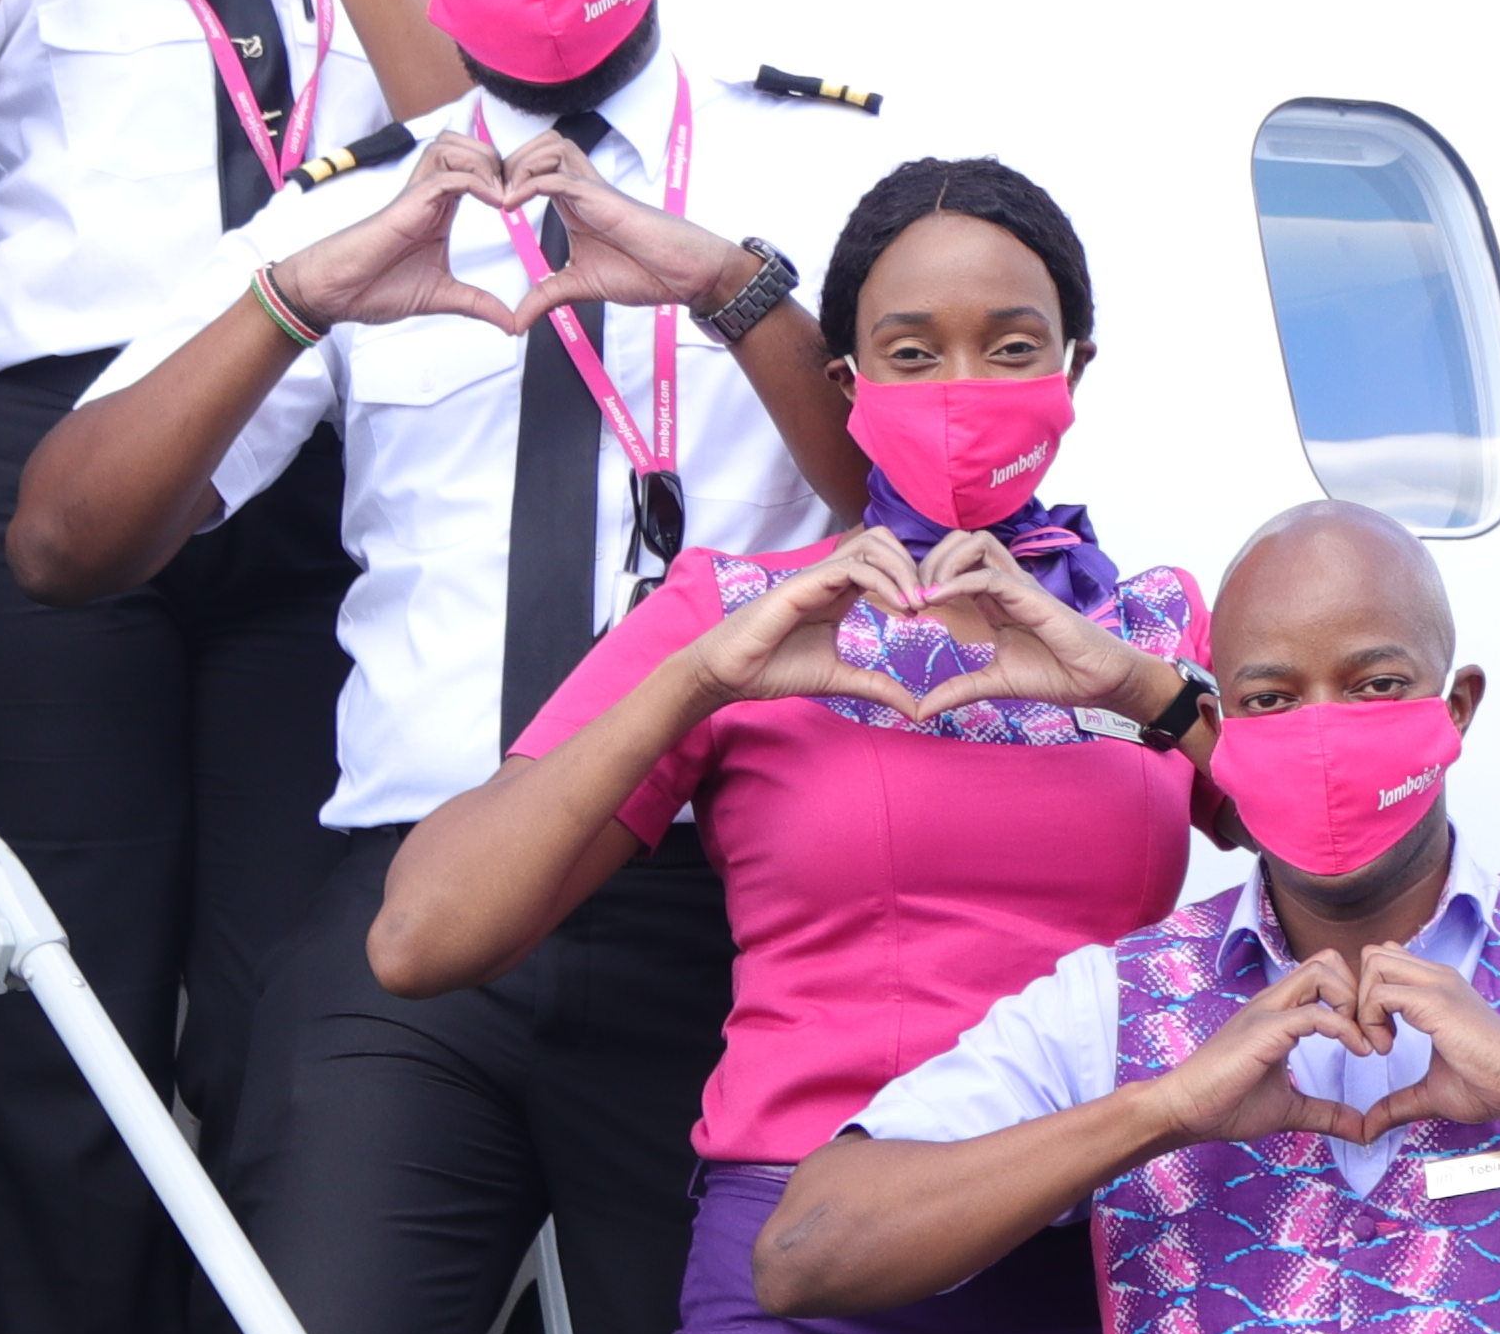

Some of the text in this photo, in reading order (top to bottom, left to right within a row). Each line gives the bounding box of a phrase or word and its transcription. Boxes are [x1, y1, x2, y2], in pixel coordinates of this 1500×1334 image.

[603, 395, 649, 467] Jambojet.com
[658, 379, 673, 459] Jambojet.com
[989, 440, 1048, 489] Jambojet
[1377, 762, 1441, 811] Jambojet
